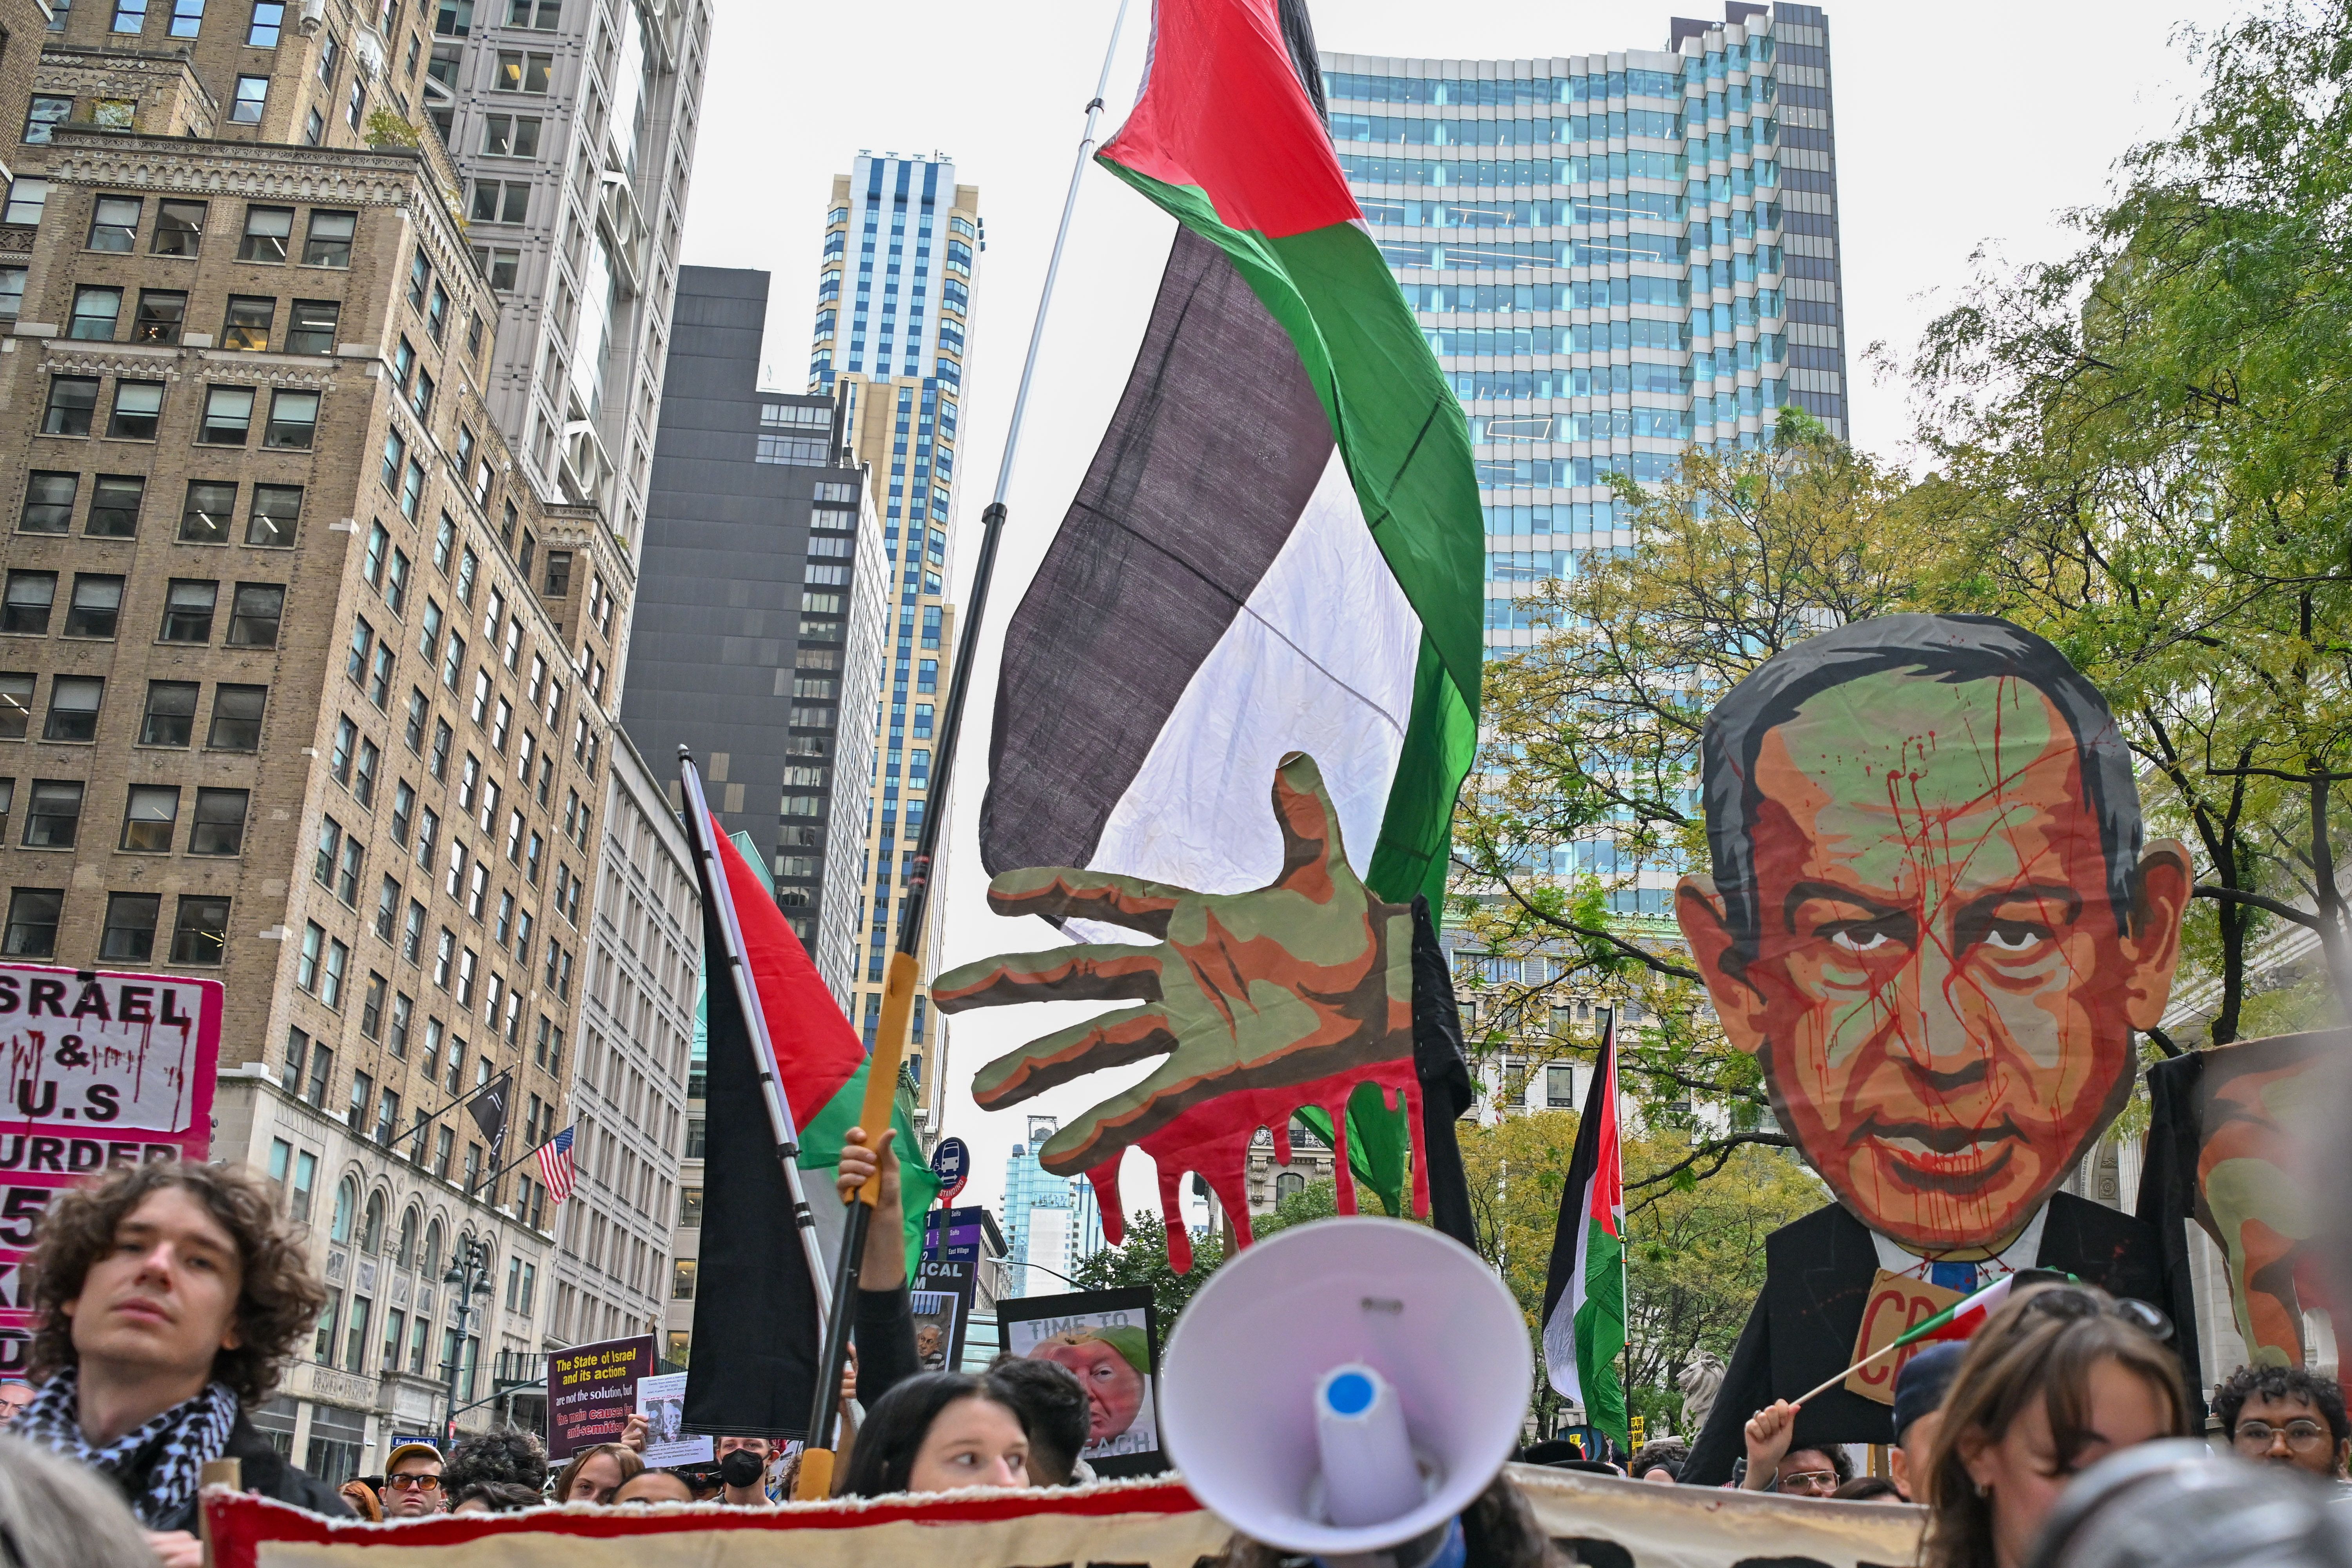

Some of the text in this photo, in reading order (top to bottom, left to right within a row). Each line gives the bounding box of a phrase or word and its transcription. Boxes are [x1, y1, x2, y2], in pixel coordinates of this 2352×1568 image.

[54, 1034, 91, 1067] &
[17, 1079, 120, 1122] U.S
[940, 1180, 964, 1197] STANDING
[1027, 1311, 1129, 1340] TIME TO
[556, 1348, 636, 1372] The State of Israel
[563, 1365, 626, 1385] and its actions
[556, 1384, 632, 1406] are not the solution, but
[557, 1403, 633, 1426] the main causes for
[567, 1420, 624, 1439] anti-semitism
